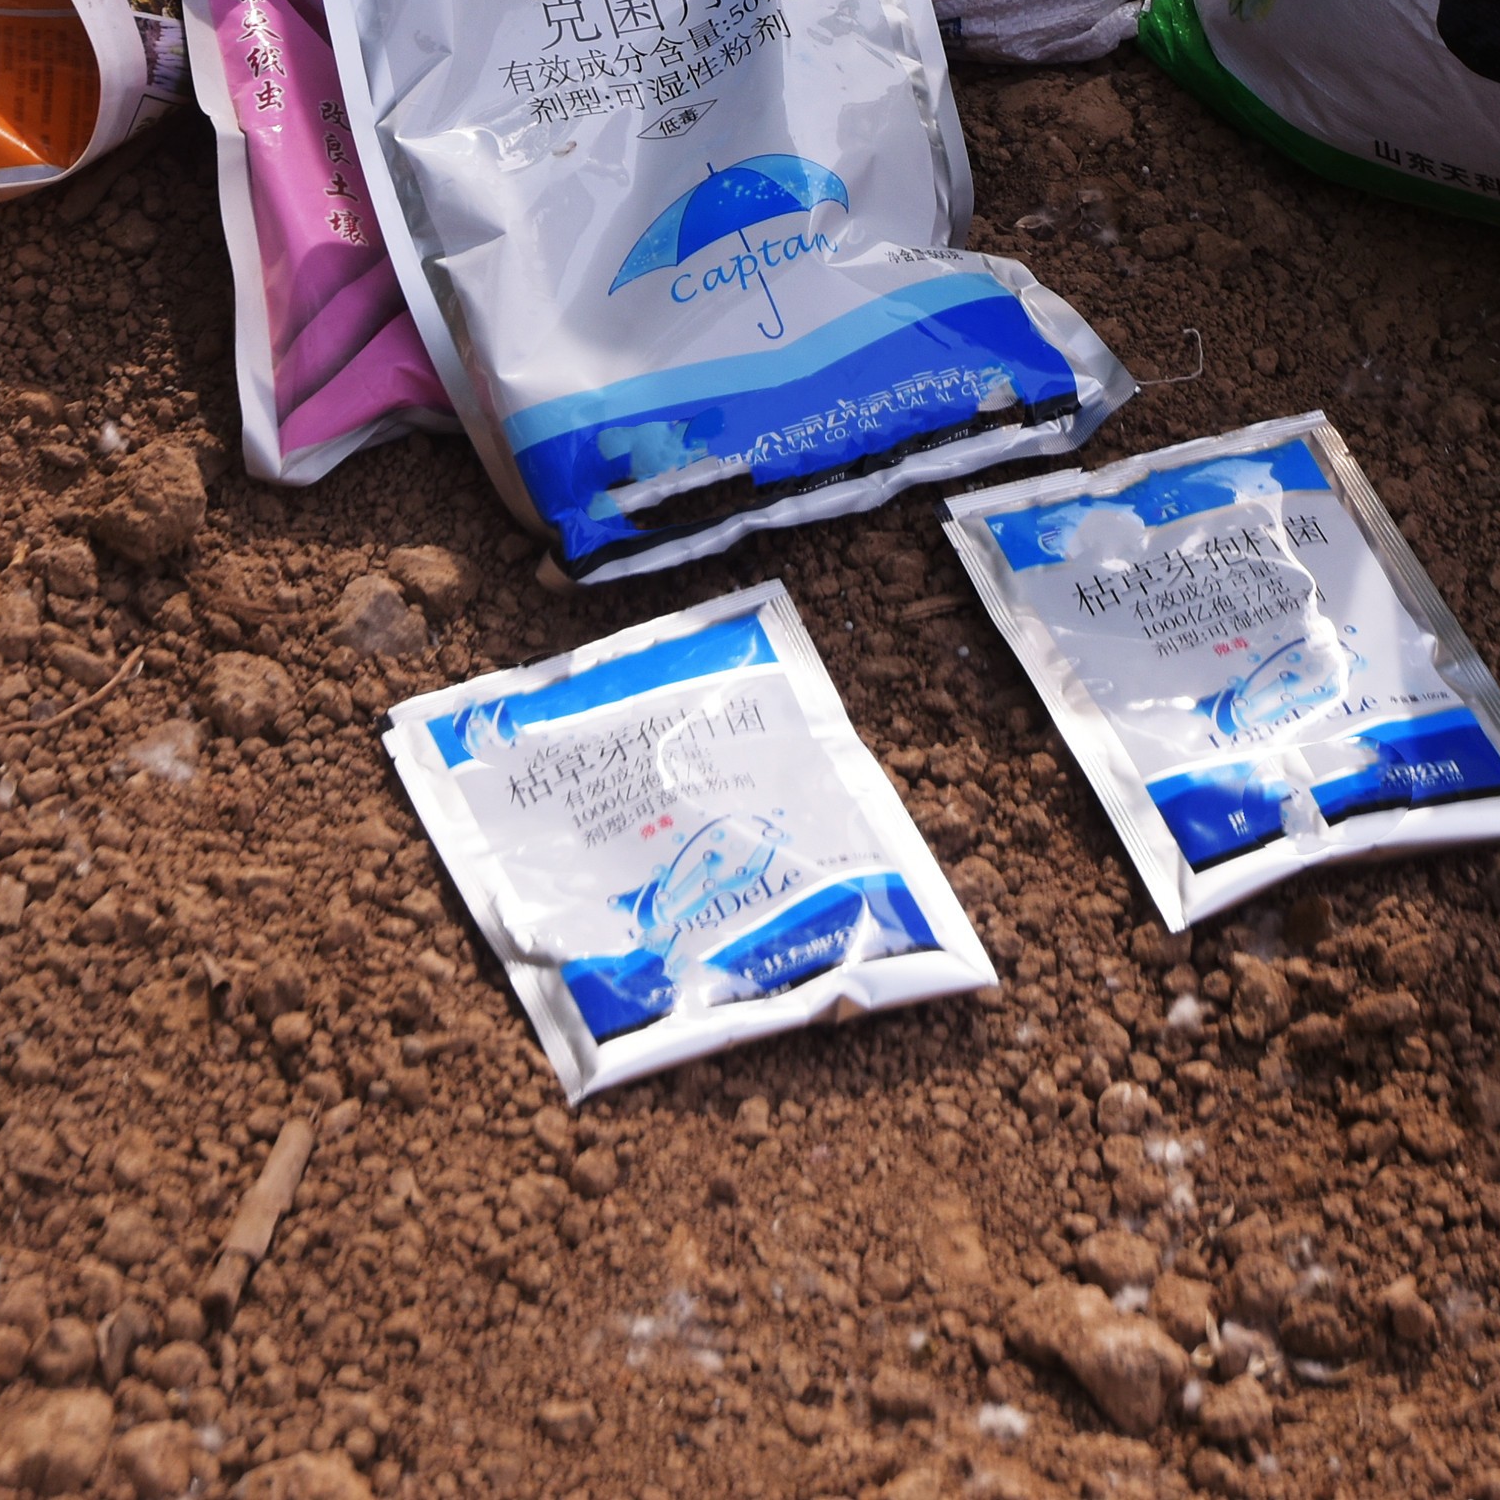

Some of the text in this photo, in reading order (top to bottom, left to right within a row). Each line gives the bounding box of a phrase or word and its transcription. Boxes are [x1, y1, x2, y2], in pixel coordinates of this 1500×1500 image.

[529, 8, 793, 126] 剂型:可湿性粉剂
[657, 104, 701, 139] 低毒
[319, 100, 370, 247] 改良土壤
[1072, 514, 1329, 618] 枯草芽孢杆菌
